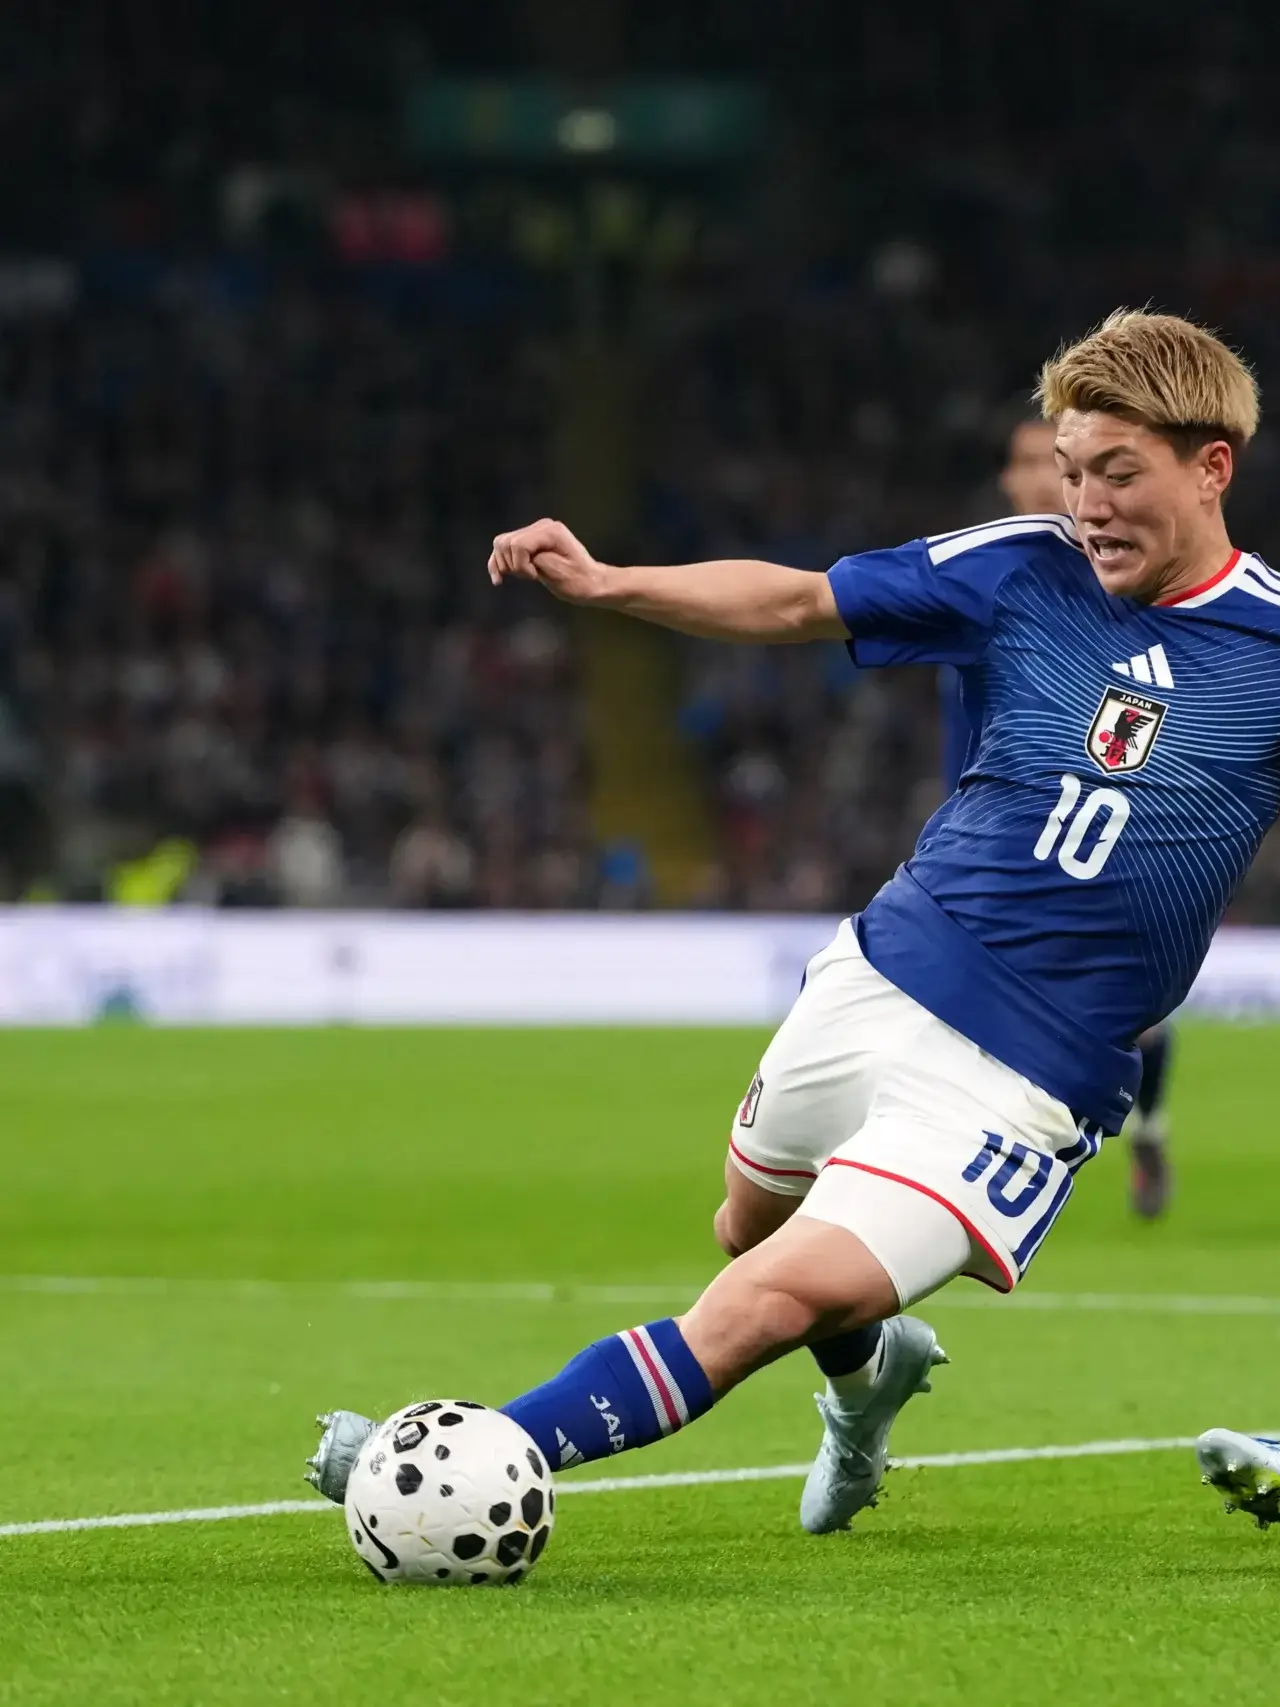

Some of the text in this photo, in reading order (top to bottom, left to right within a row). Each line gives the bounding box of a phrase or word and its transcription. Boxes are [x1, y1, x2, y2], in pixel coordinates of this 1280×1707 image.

[1120, 694, 1152, 710] JAPAN
[1033, 773, 1130, 880] 10
[961, 1129, 1054, 1218] 10
[590, 1394, 625, 1455] JAP
